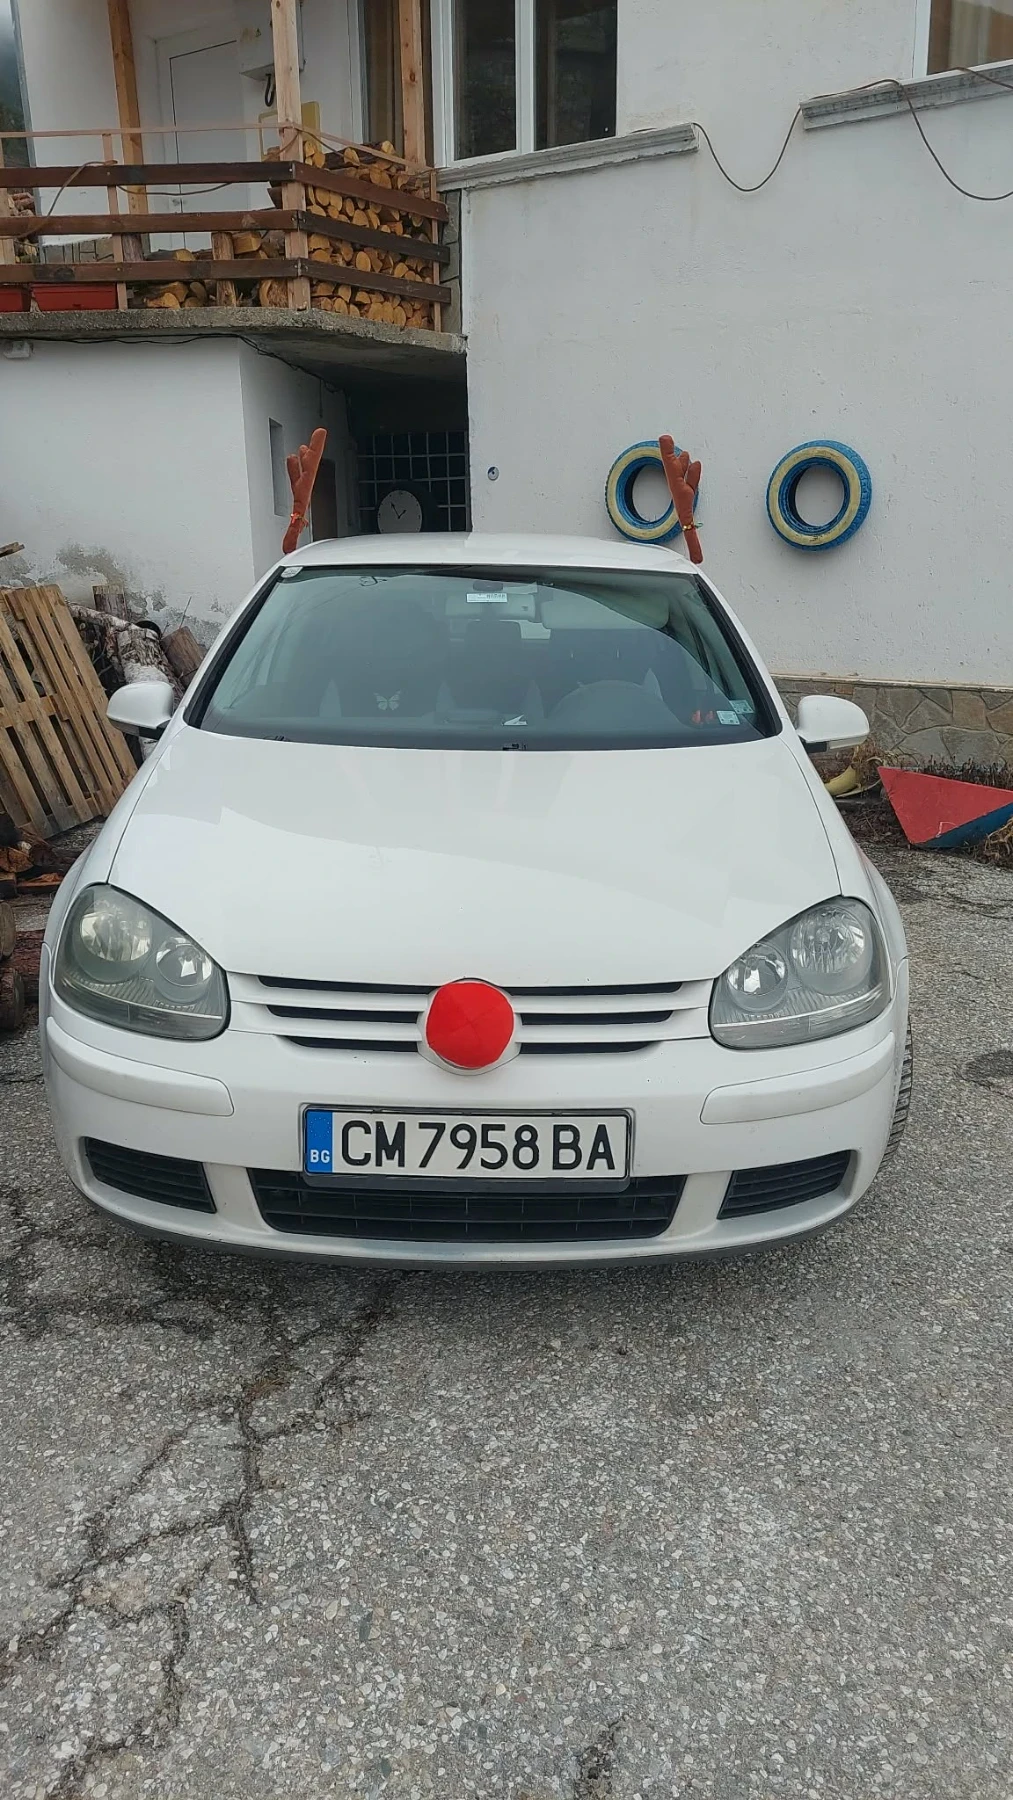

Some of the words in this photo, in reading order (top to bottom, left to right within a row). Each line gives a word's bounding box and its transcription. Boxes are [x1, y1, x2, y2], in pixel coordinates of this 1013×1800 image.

[310, 1149, 330, 1164] BG
[341, 1120, 406, 1168] CM
[418, 1122, 540, 1170] 7958
[552, 1124, 616, 1170] BA
